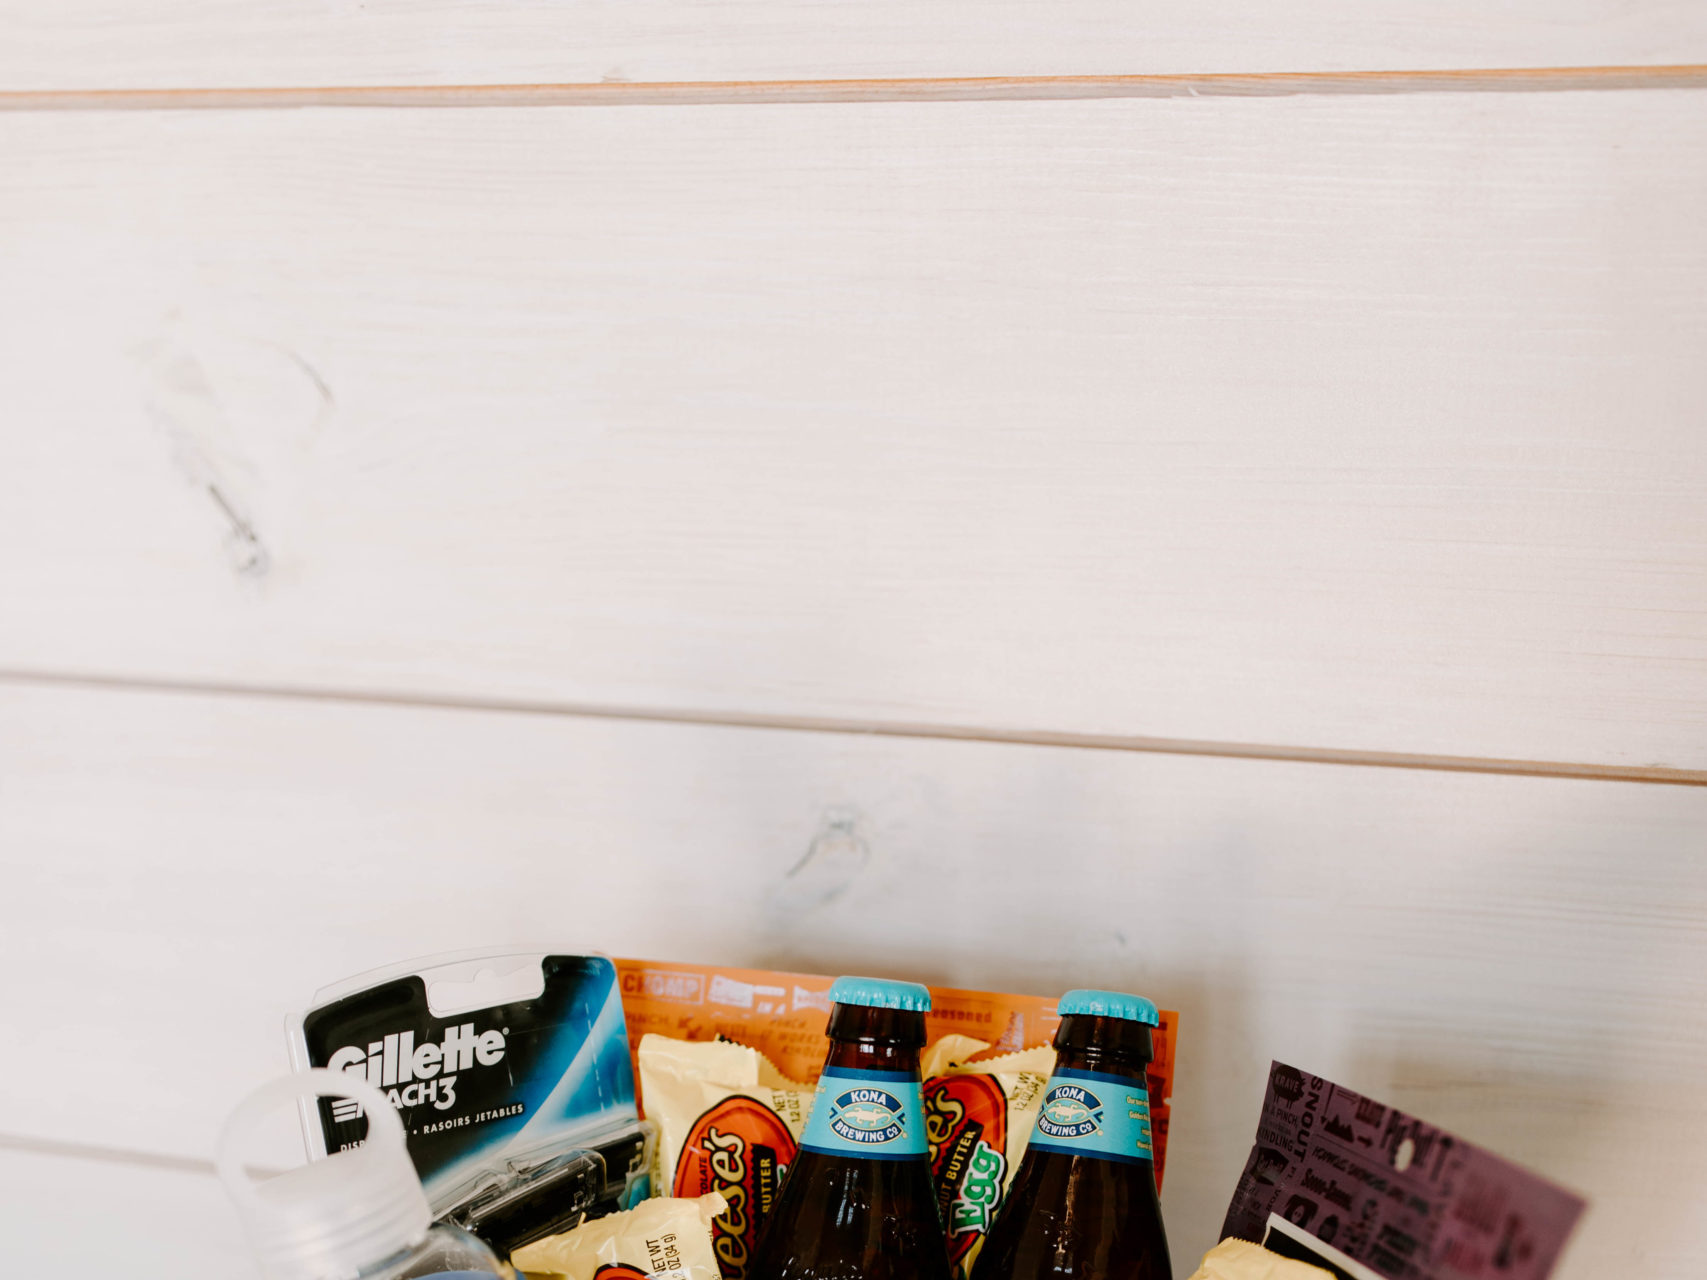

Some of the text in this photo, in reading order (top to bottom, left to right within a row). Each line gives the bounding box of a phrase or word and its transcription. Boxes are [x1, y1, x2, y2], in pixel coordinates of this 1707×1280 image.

[850, 1090, 887, 1106] KONA
[1055, 1086, 1086, 1103] KONA
[423, 1104, 524, 1135] RASOIRS JETABLES
[1039, 1117, 1077, 1137] BREWING
[1293, 1076, 1323, 1163] SNOUT
[834, 1120, 885, 1143] BREWING
[945, 1130, 977, 1181] BUTTER
[759, 1158, 773, 1213] BUTTER
[950, 1143, 1001, 1233] Egg
[645, 1239, 662, 1257] WT
[667, 1256, 682, 1271] OZ
